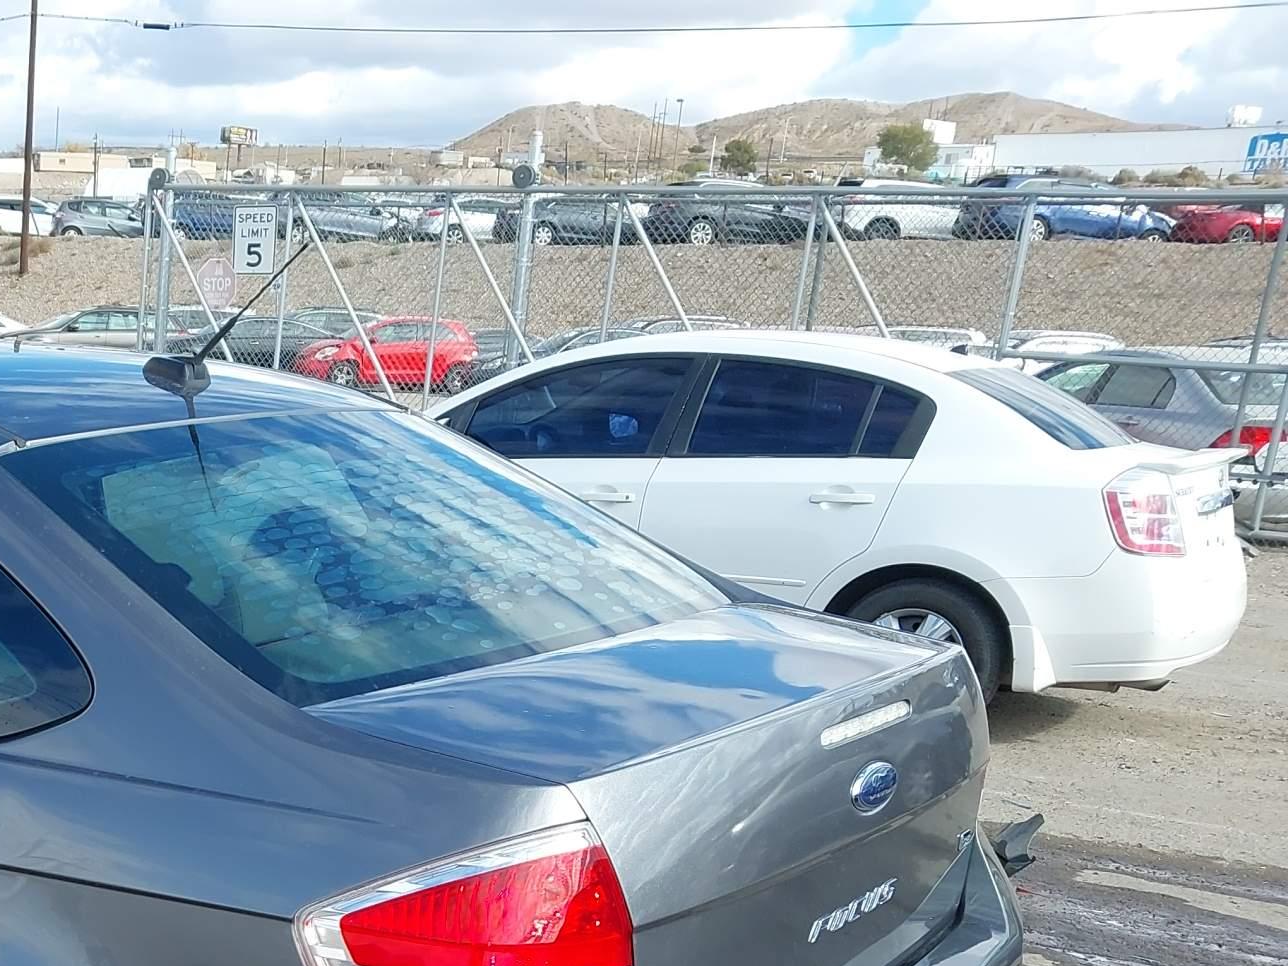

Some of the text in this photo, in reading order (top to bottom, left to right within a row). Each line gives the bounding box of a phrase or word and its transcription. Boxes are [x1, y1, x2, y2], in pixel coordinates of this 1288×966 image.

[238, 213, 273, 223] SPEED
[241, 228, 269, 238] LIMIT
[246, 243, 262, 267] 5
[203, 278, 232, 292] STOP
[808, 877, 898, 943] FOCUS
